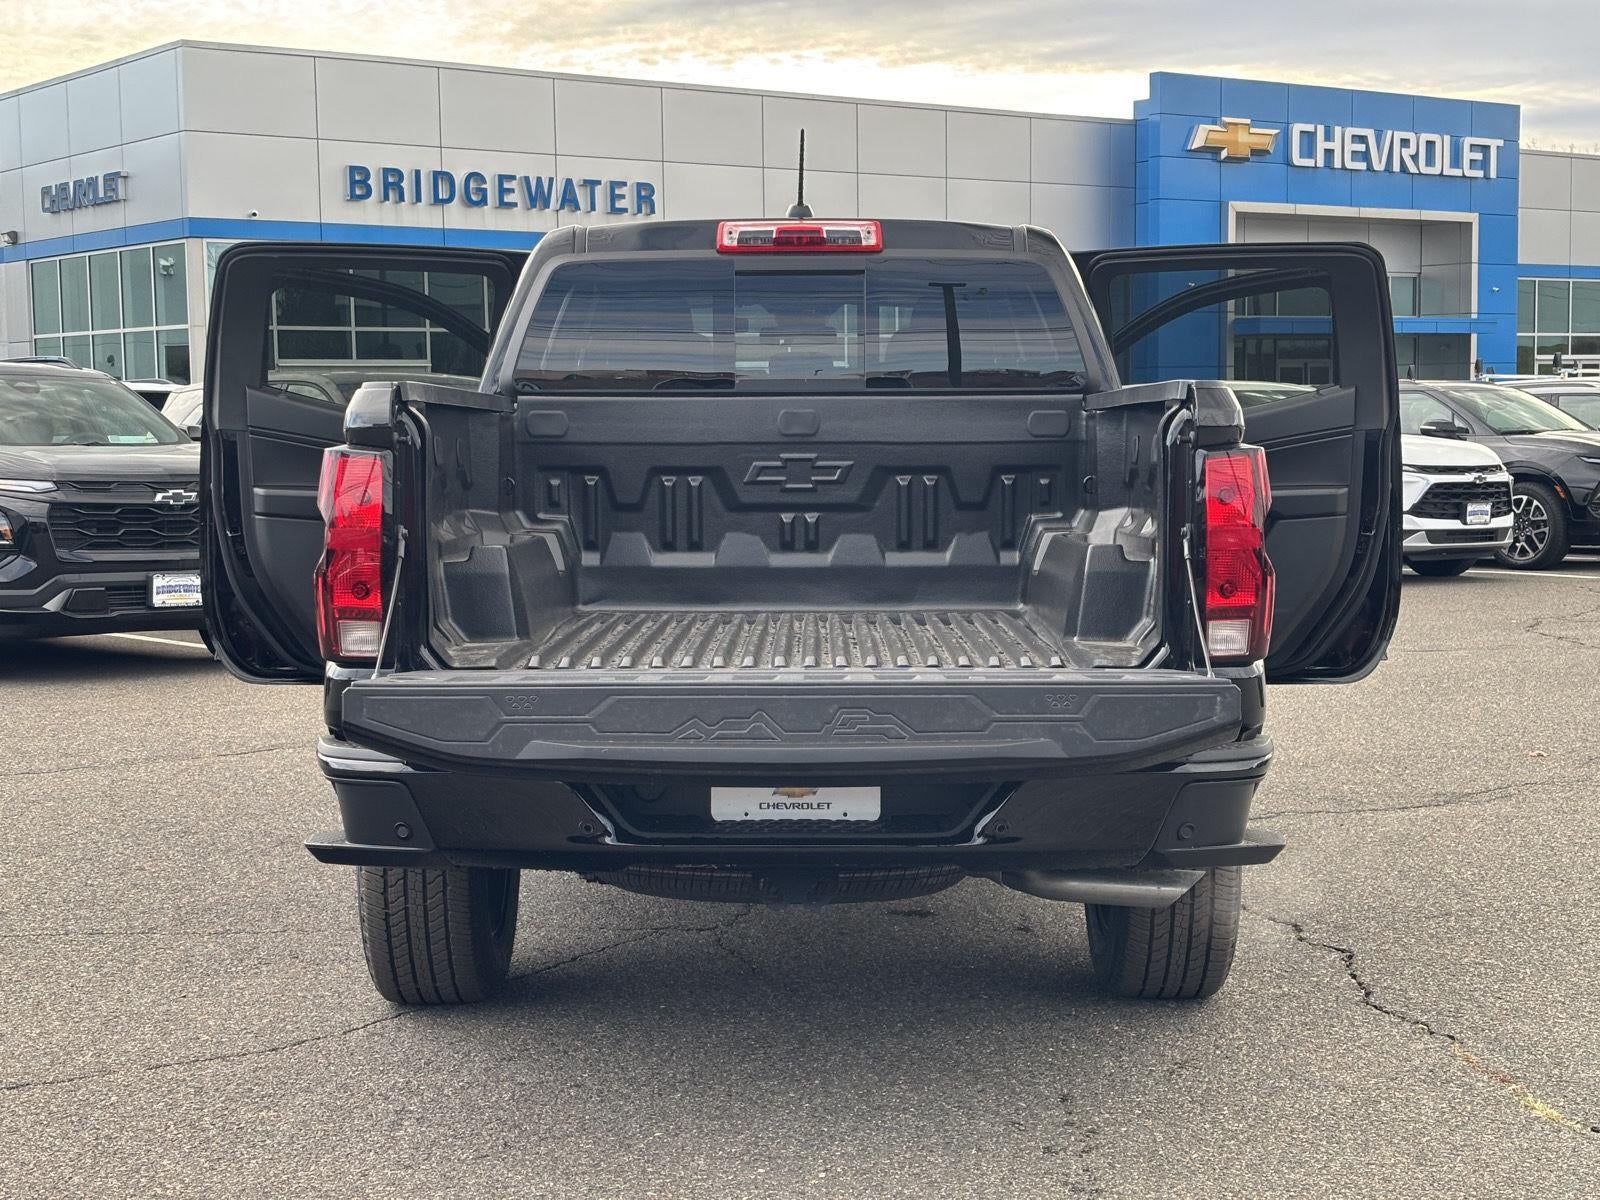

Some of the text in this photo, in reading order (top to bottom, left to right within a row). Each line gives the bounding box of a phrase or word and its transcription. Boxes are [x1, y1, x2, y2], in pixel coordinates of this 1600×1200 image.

[1292, 123, 1504, 178] CHEVROLET
[41, 171, 126, 213] CHEVROLET
[348, 165, 656, 215] BRIDGEWATER
[156, 583, 200, 595] BRIDGEWATE
[759, 802, 832, 810] CHEVROLET
